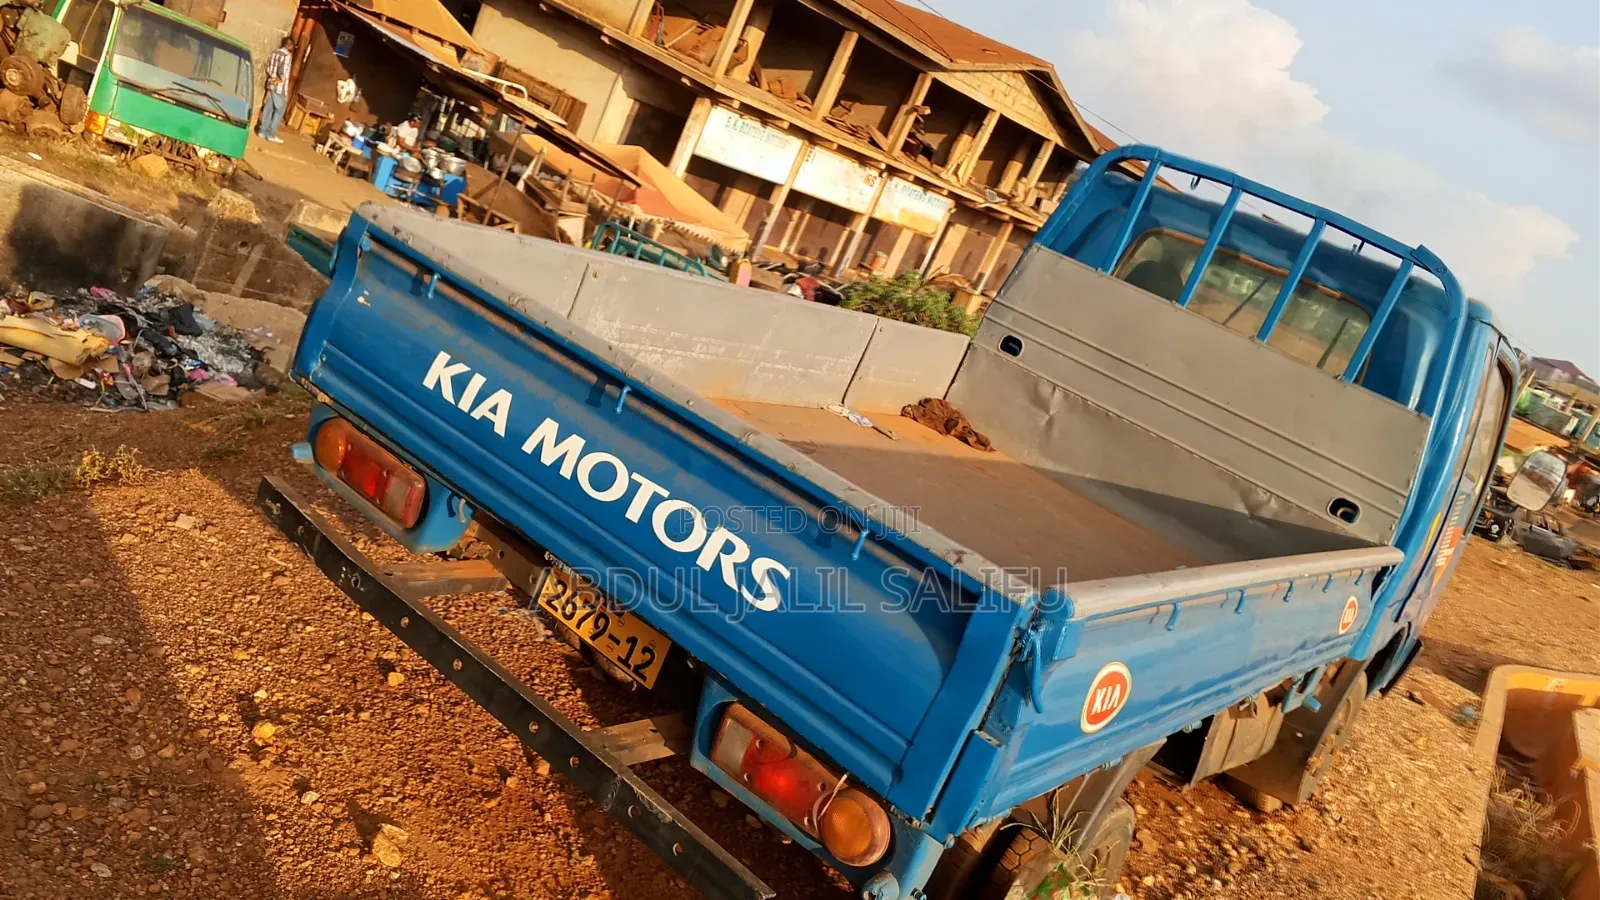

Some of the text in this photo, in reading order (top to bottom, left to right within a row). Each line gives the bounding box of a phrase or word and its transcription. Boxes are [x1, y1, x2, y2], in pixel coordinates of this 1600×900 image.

[423, 351, 790, 611] KIA MOTORS
[545, 579, 656, 682] 2679-12
[1091, 683, 1121, 716] KIA
